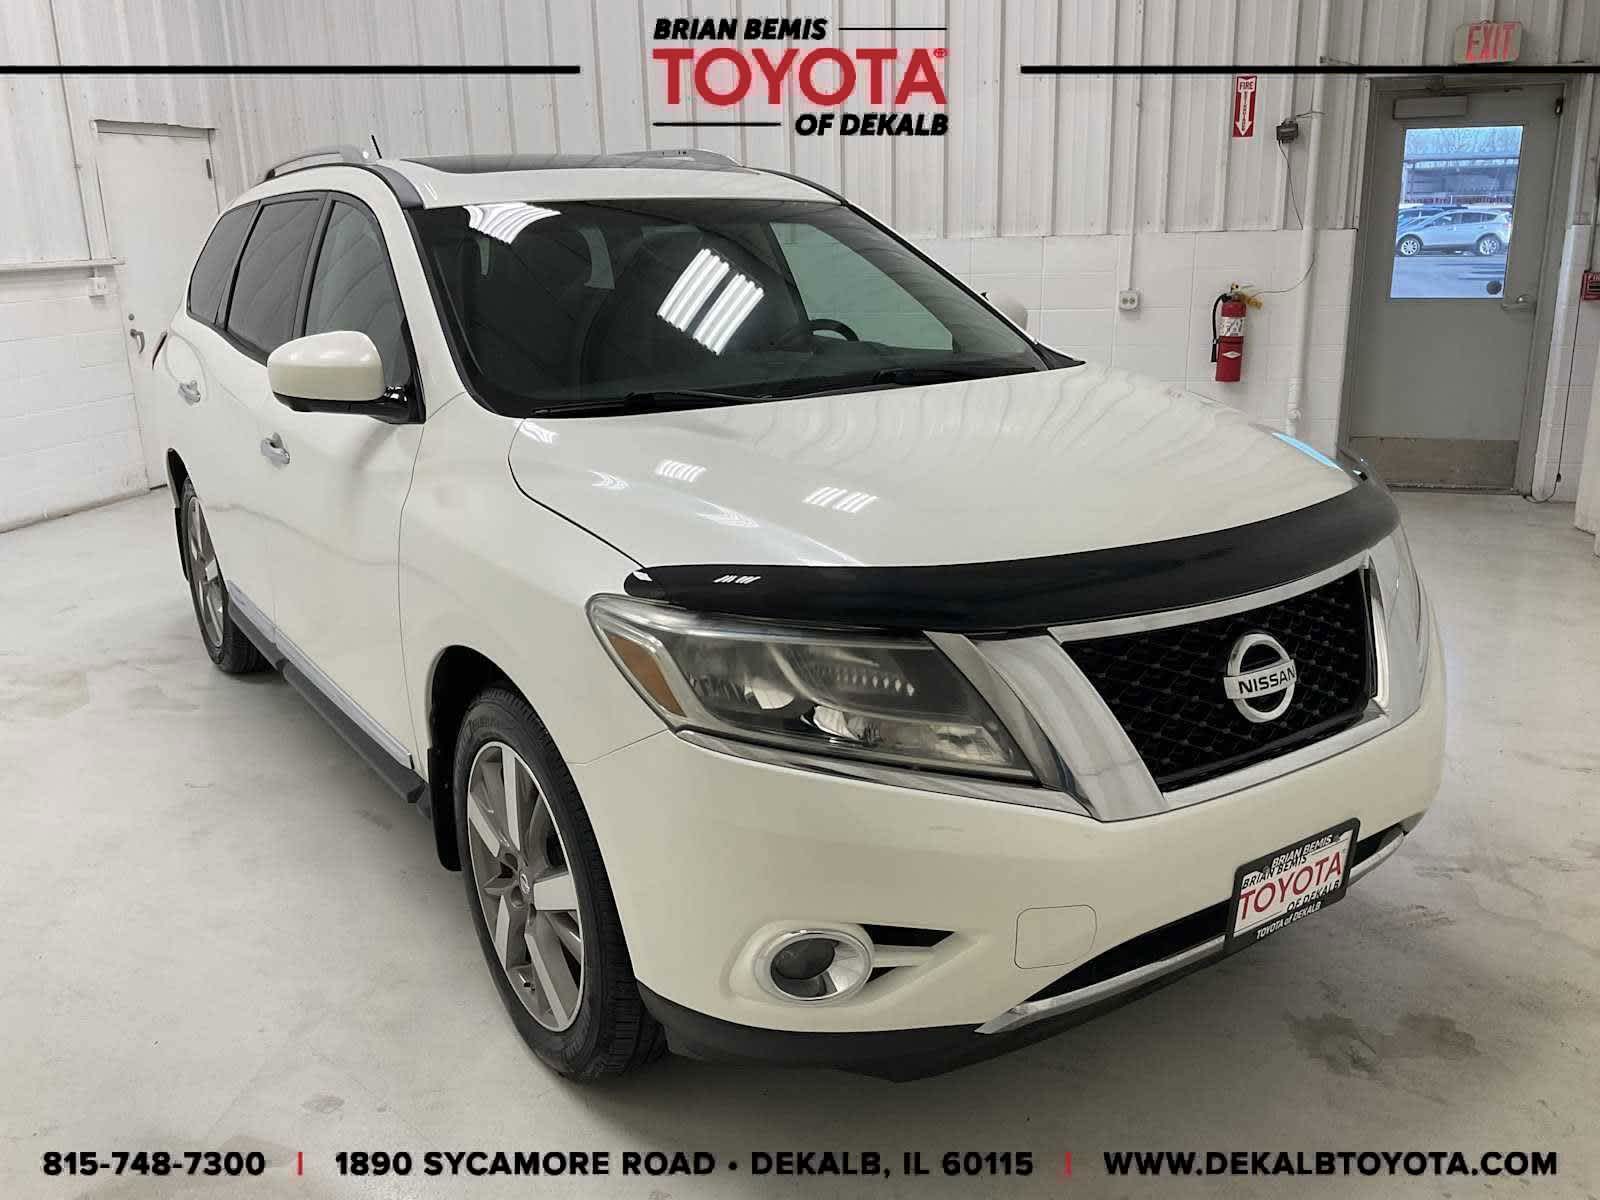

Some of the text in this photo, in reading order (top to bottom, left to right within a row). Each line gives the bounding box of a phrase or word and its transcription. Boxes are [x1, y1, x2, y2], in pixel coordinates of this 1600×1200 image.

[1466, 24, 1515, 61] EXIT
[1240, 81, 1254, 90] FIRE
[1238, 665, 1295, 694] NISSAN
[1271, 834, 1333, 867] BRIAN BEMIS
[1240, 851, 1342, 921] TOYOTA
[1256, 919, 1284, 940] TOYOTA
[1292, 901, 1322, 921] DEKALB
